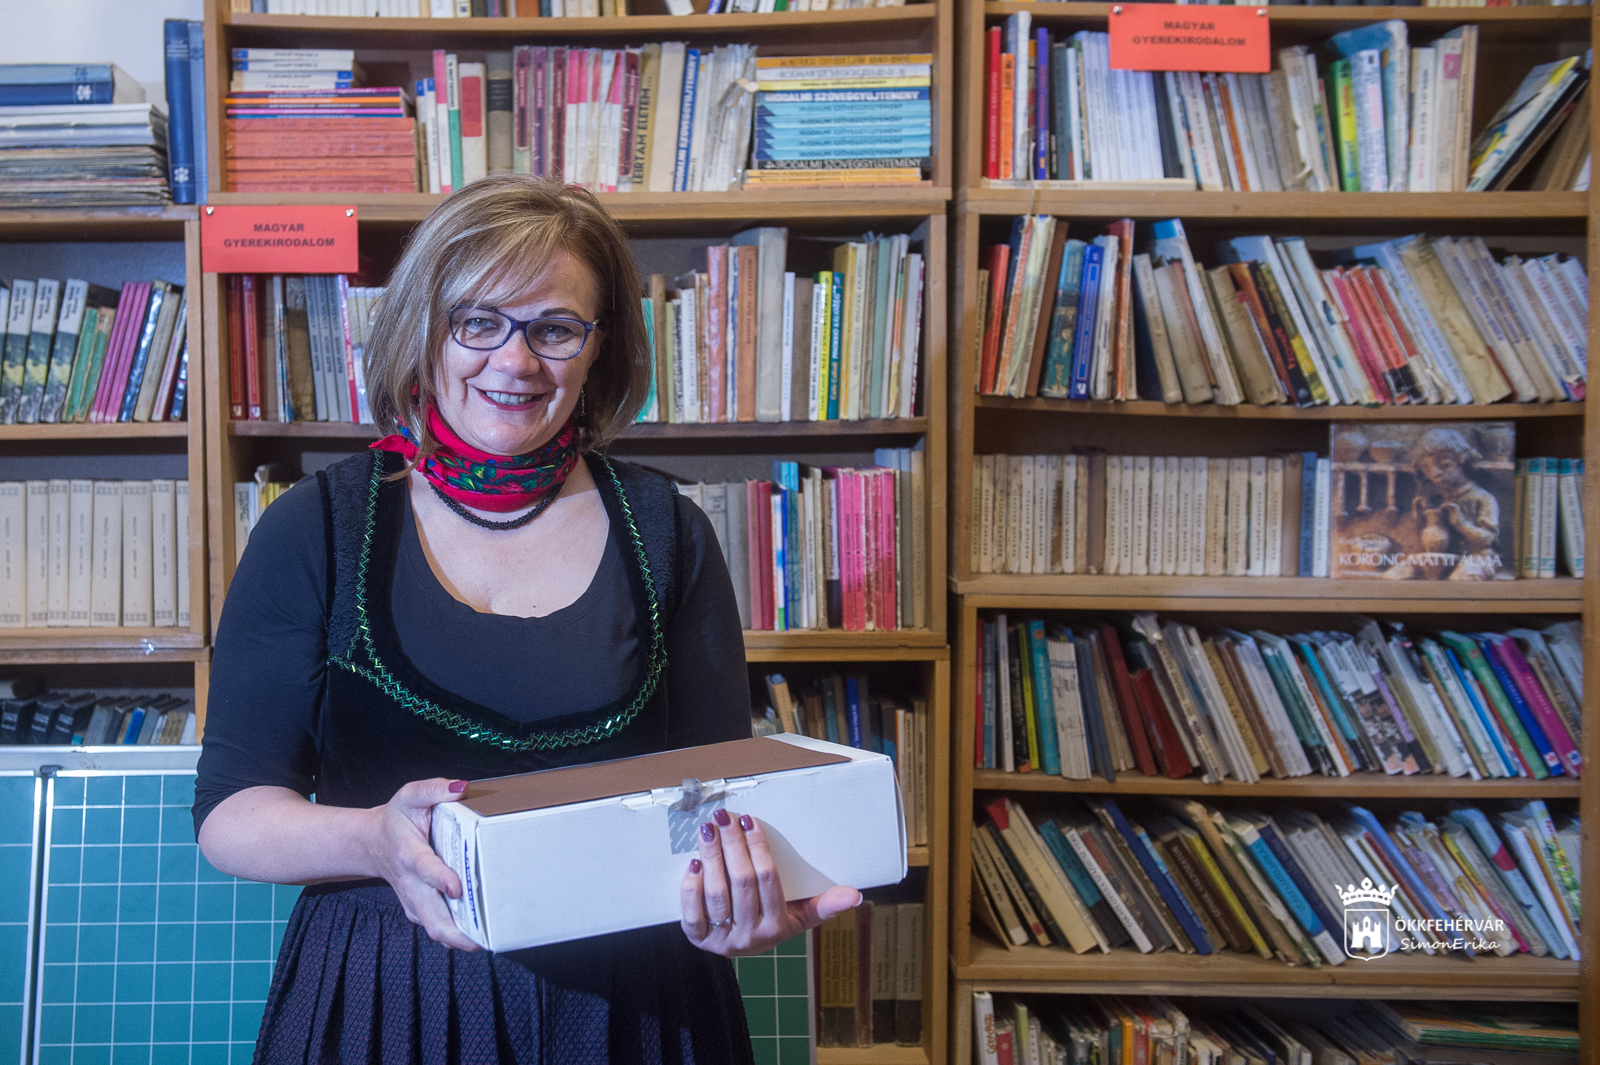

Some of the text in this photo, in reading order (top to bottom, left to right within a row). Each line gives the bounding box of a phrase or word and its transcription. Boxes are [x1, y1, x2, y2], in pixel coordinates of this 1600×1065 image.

[1164, 21, 1215, 30] MAGYAR
[1132, 35, 1246, 46] GYEREKIRODALOM
[253, 223, 304, 232] MAGYAR
[223, 238, 335, 247] GYEREKIRODALOM
[1339, 552, 1405, 566] KORONG
